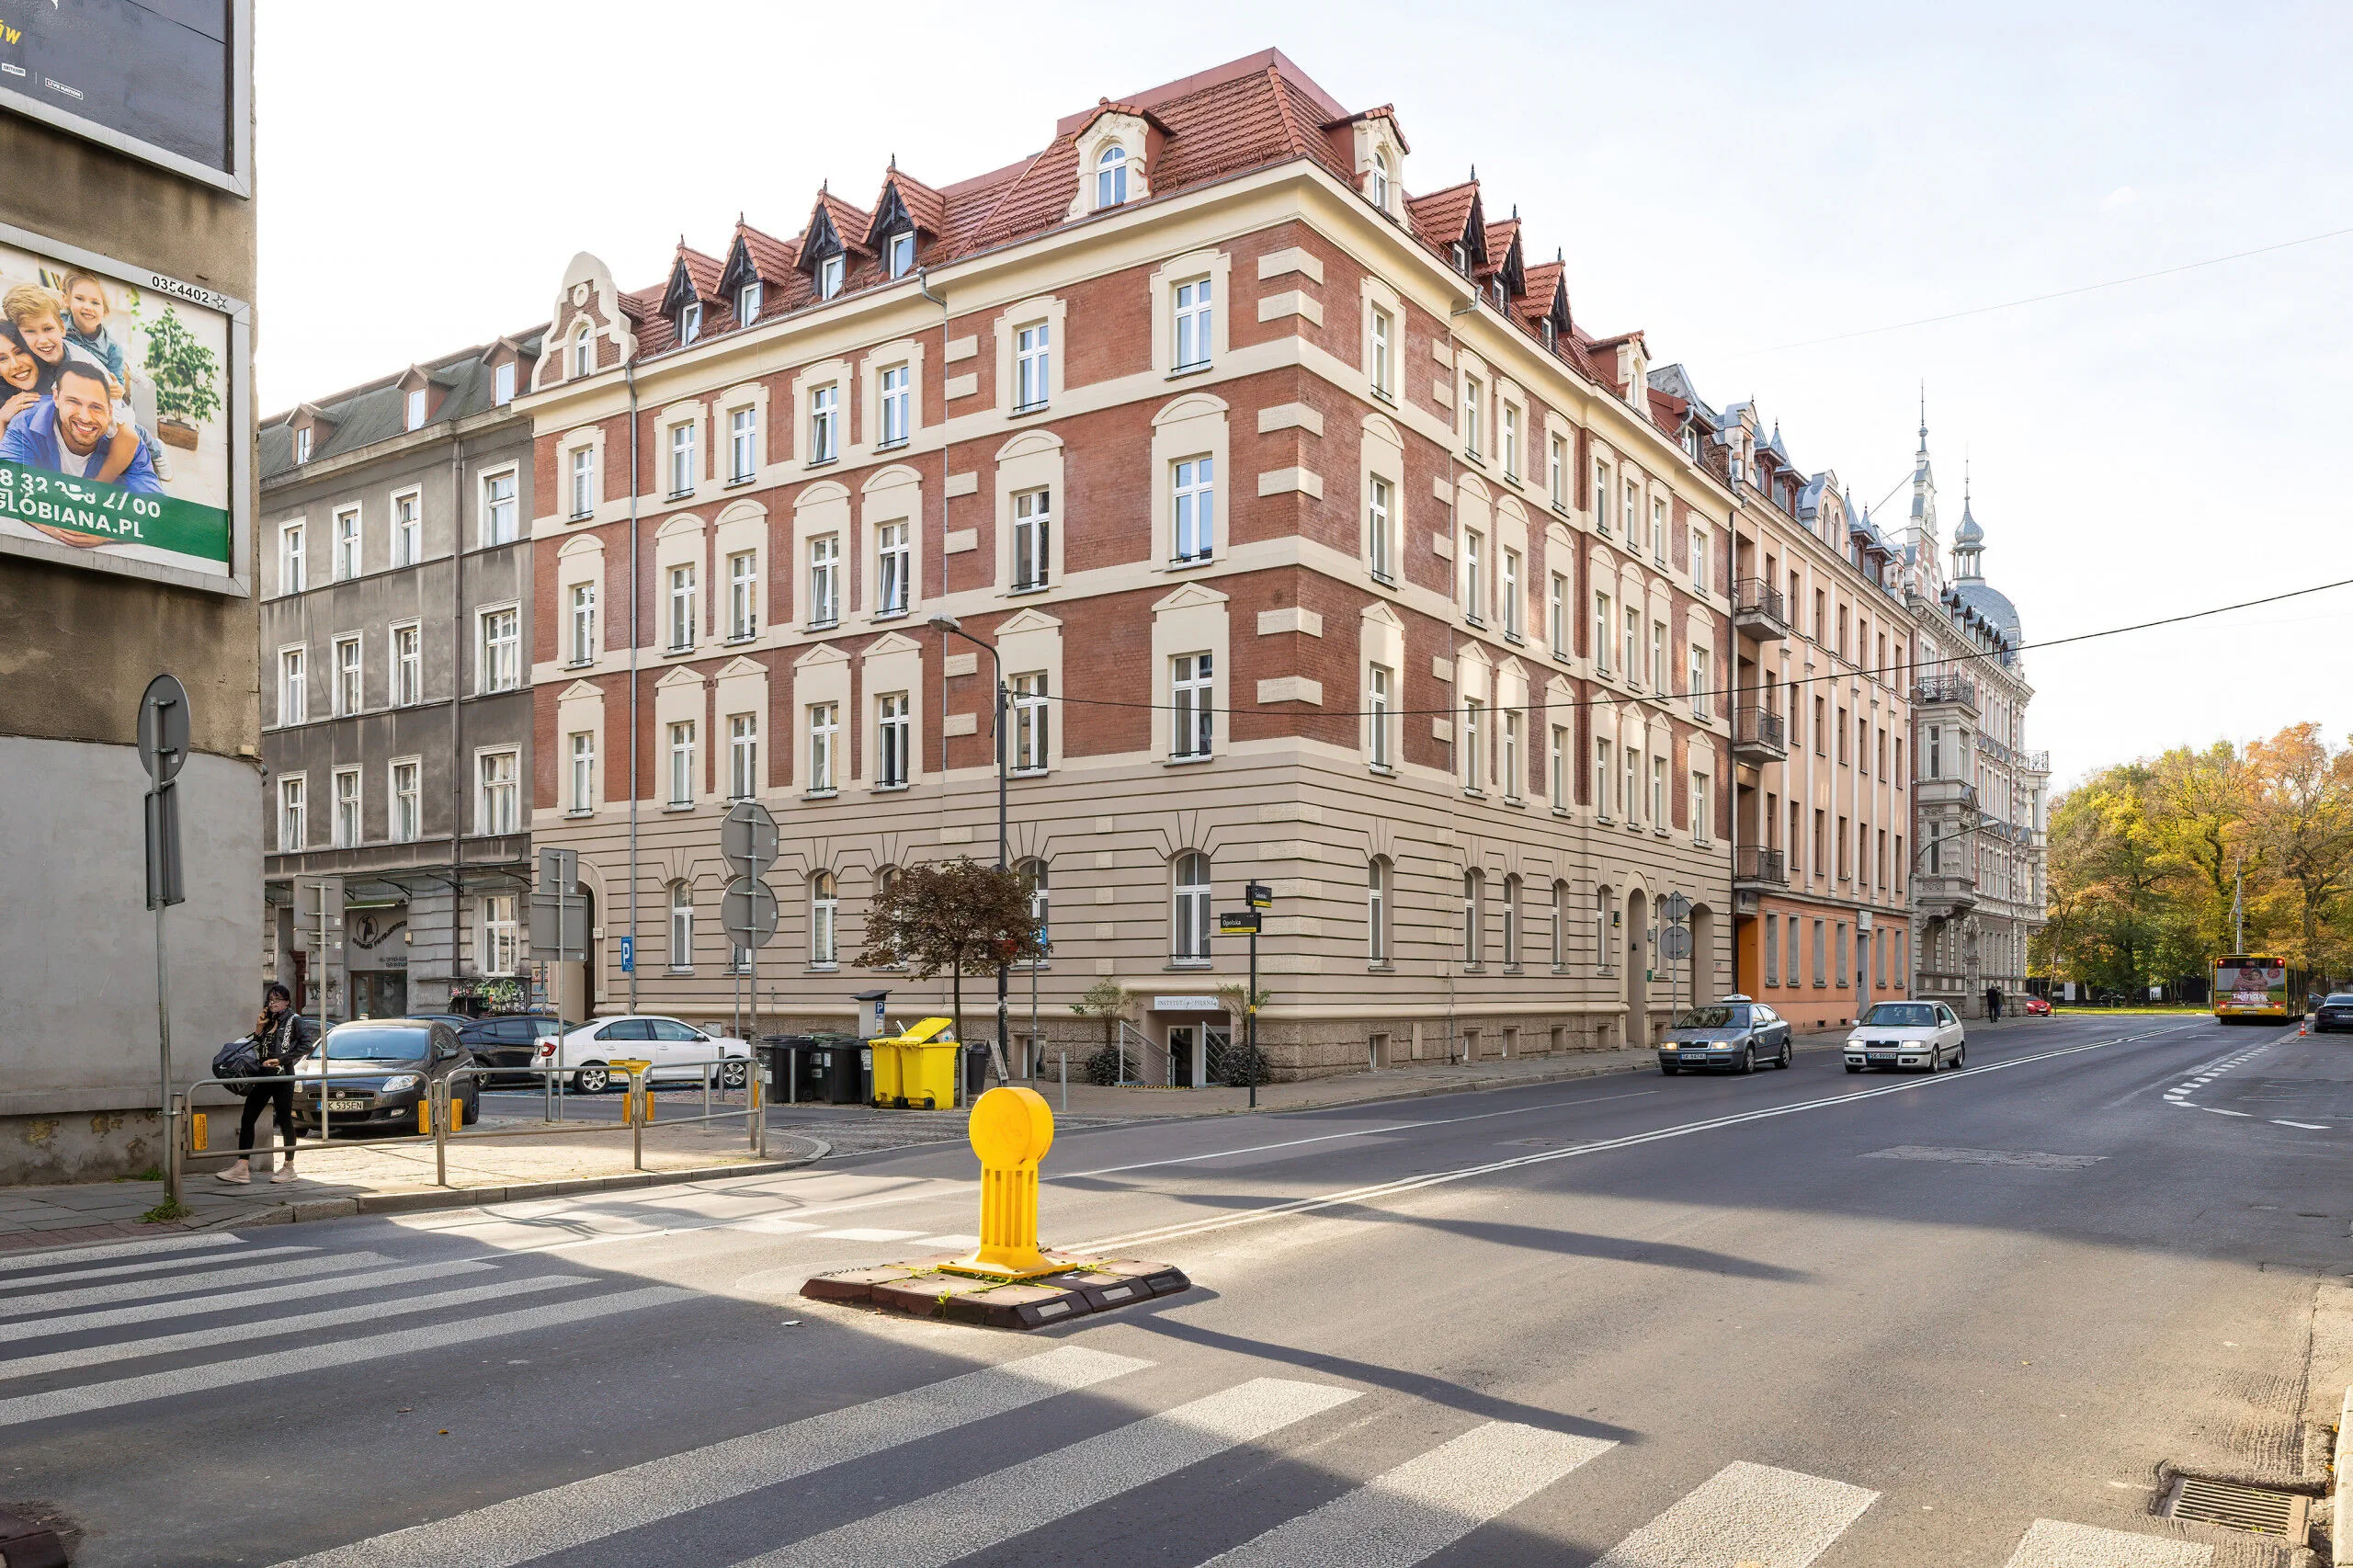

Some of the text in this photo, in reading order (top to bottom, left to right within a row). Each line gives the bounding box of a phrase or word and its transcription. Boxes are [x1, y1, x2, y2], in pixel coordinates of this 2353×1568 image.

[47, 79, 81, 97] LIVE NATION
[152, 276, 209, 304] 0354402
[132, 498, 161, 518] 00
[1222, 919, 1242, 927] Opolska
[622, 942, 631, 965] P
[877, 1002, 883, 1013] P
[336, 1101, 362, 1109] 535EN
